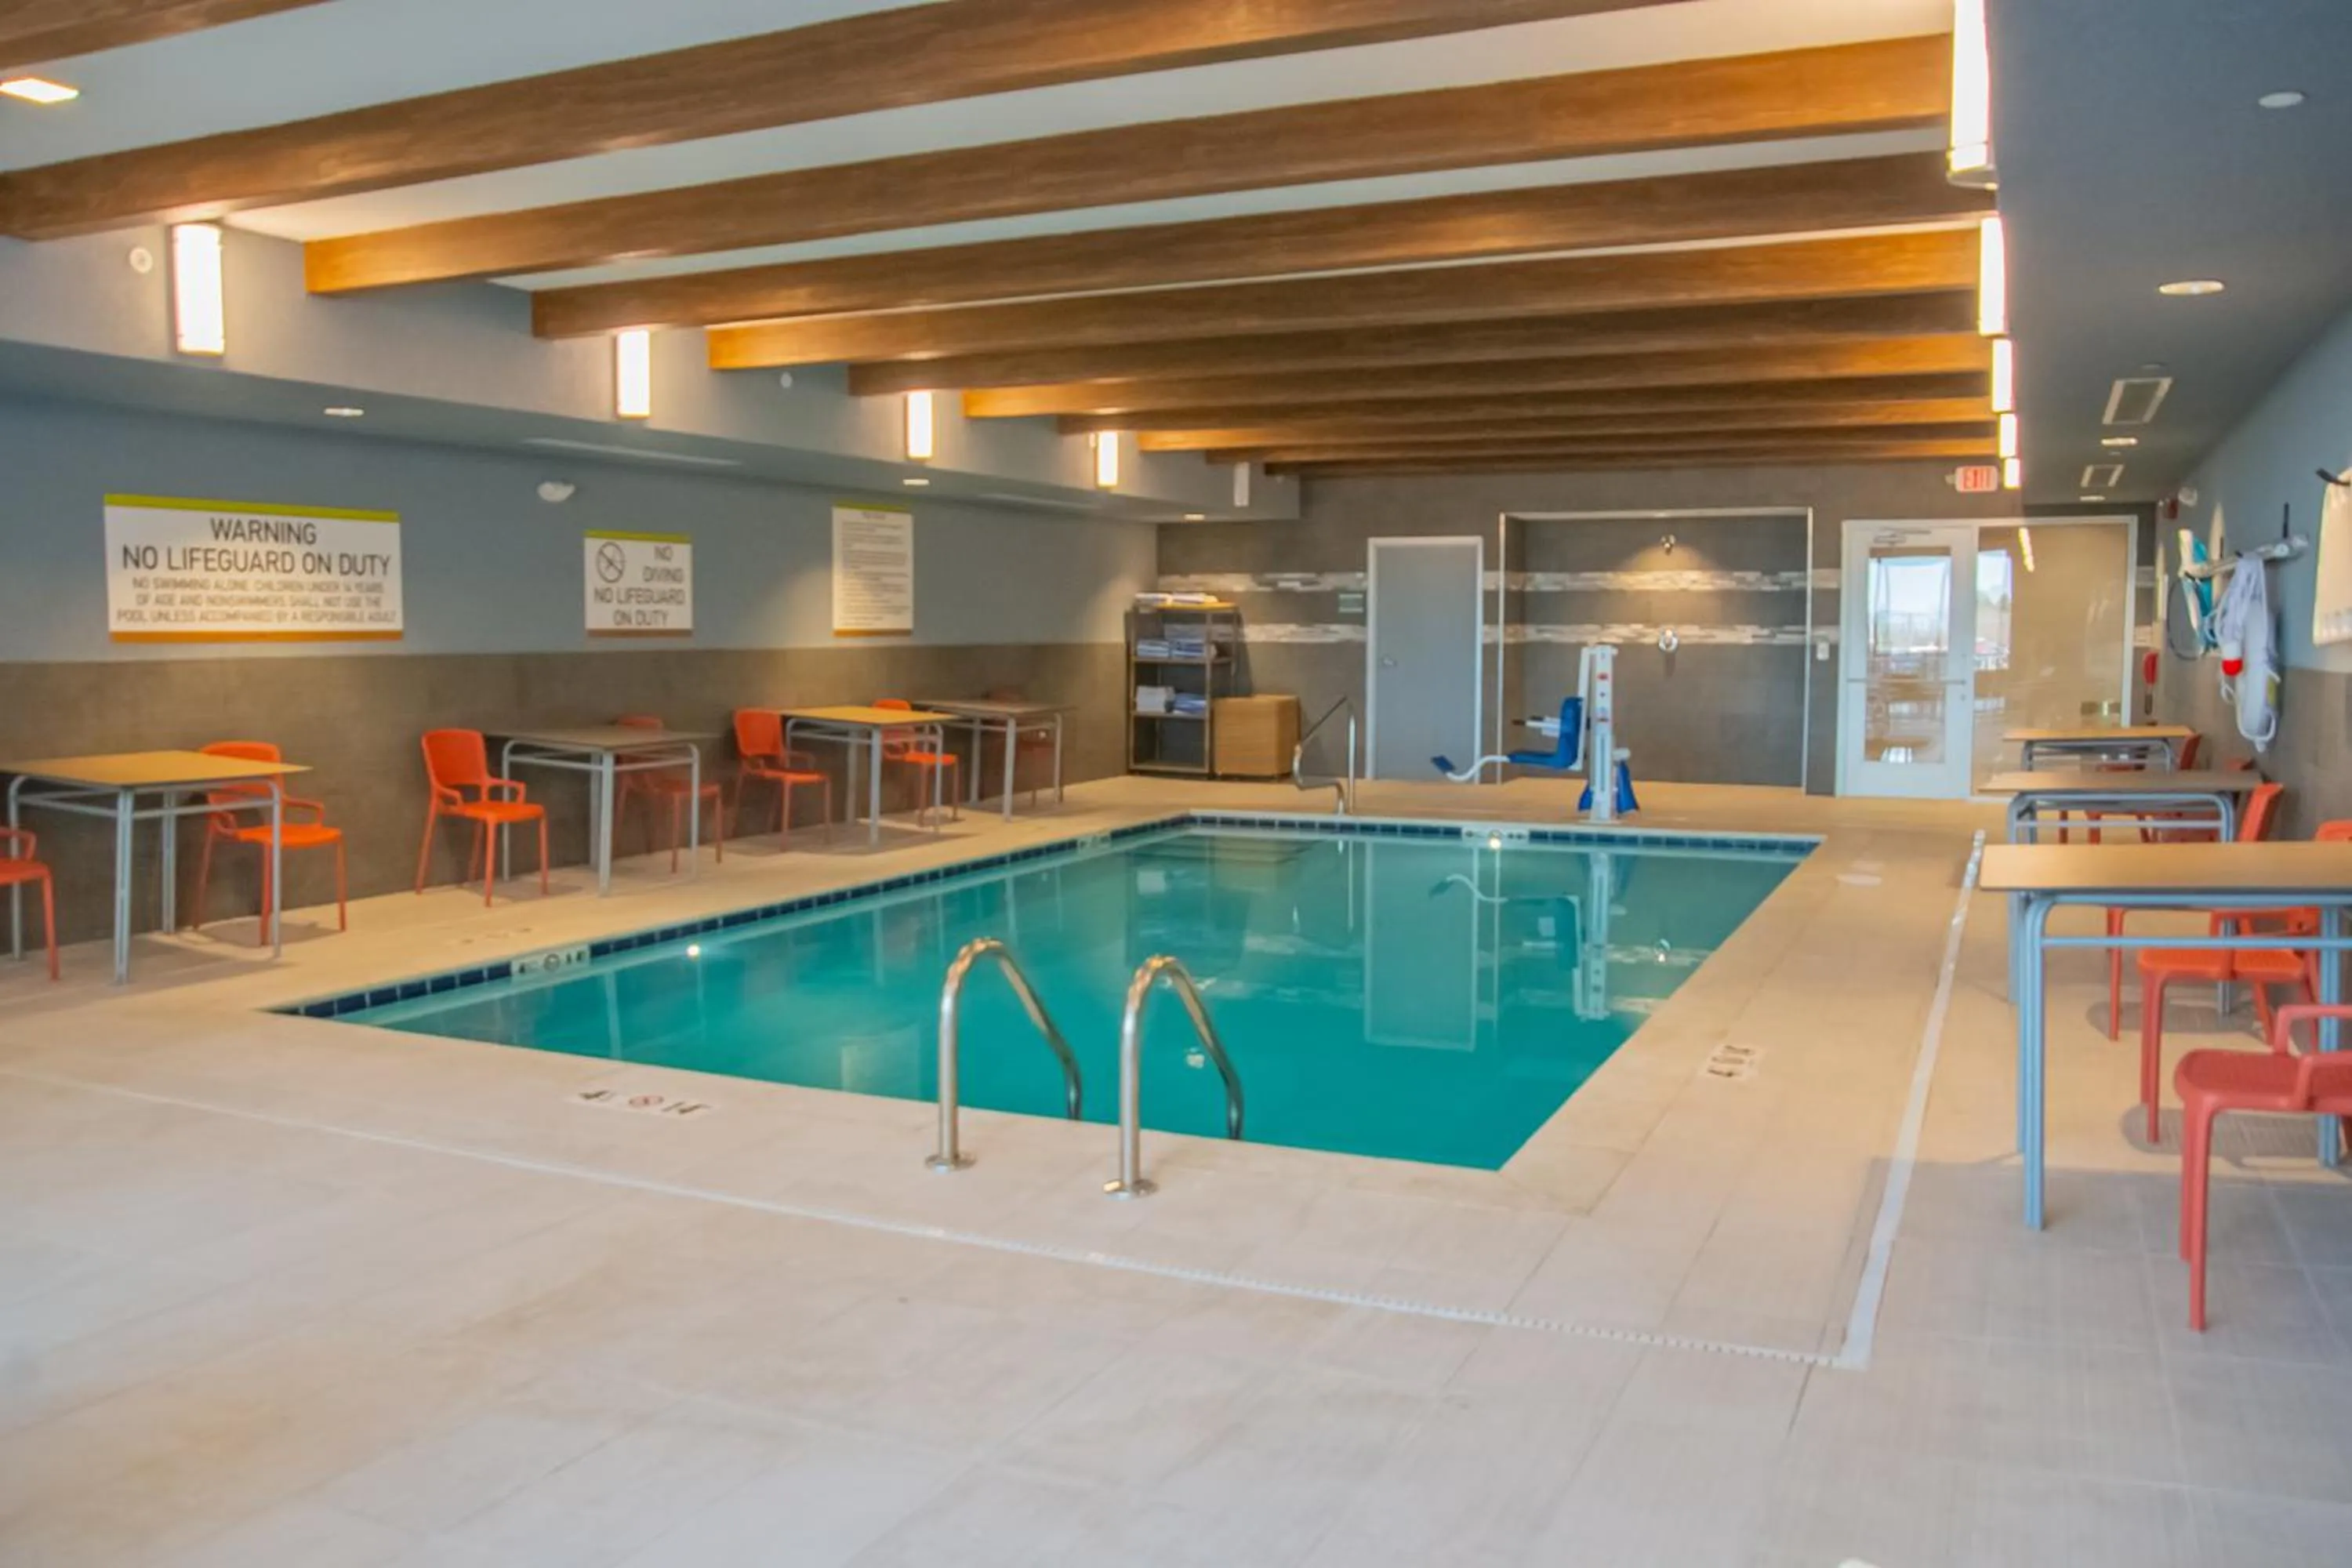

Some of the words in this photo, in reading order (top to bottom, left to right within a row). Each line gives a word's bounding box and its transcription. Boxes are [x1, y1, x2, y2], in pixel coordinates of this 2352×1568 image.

[1962, 468, 1992, 488] EXIT
[209, 517, 318, 545] WARNING
[122, 544, 158, 570] NO
[167, 546, 295, 573] LIFEGUARD
[302, 551, 332, 575] ON
[339, 553, 390, 576] DUTY
[654, 546, 673, 561] NO
[642, 565, 684, 583] DIVING
[593, 587, 613, 604] NO
[616, 587, 686, 604] LIFEGUARD
[613, 608, 633, 626] ON
[636, 608, 668, 626] DUTY
